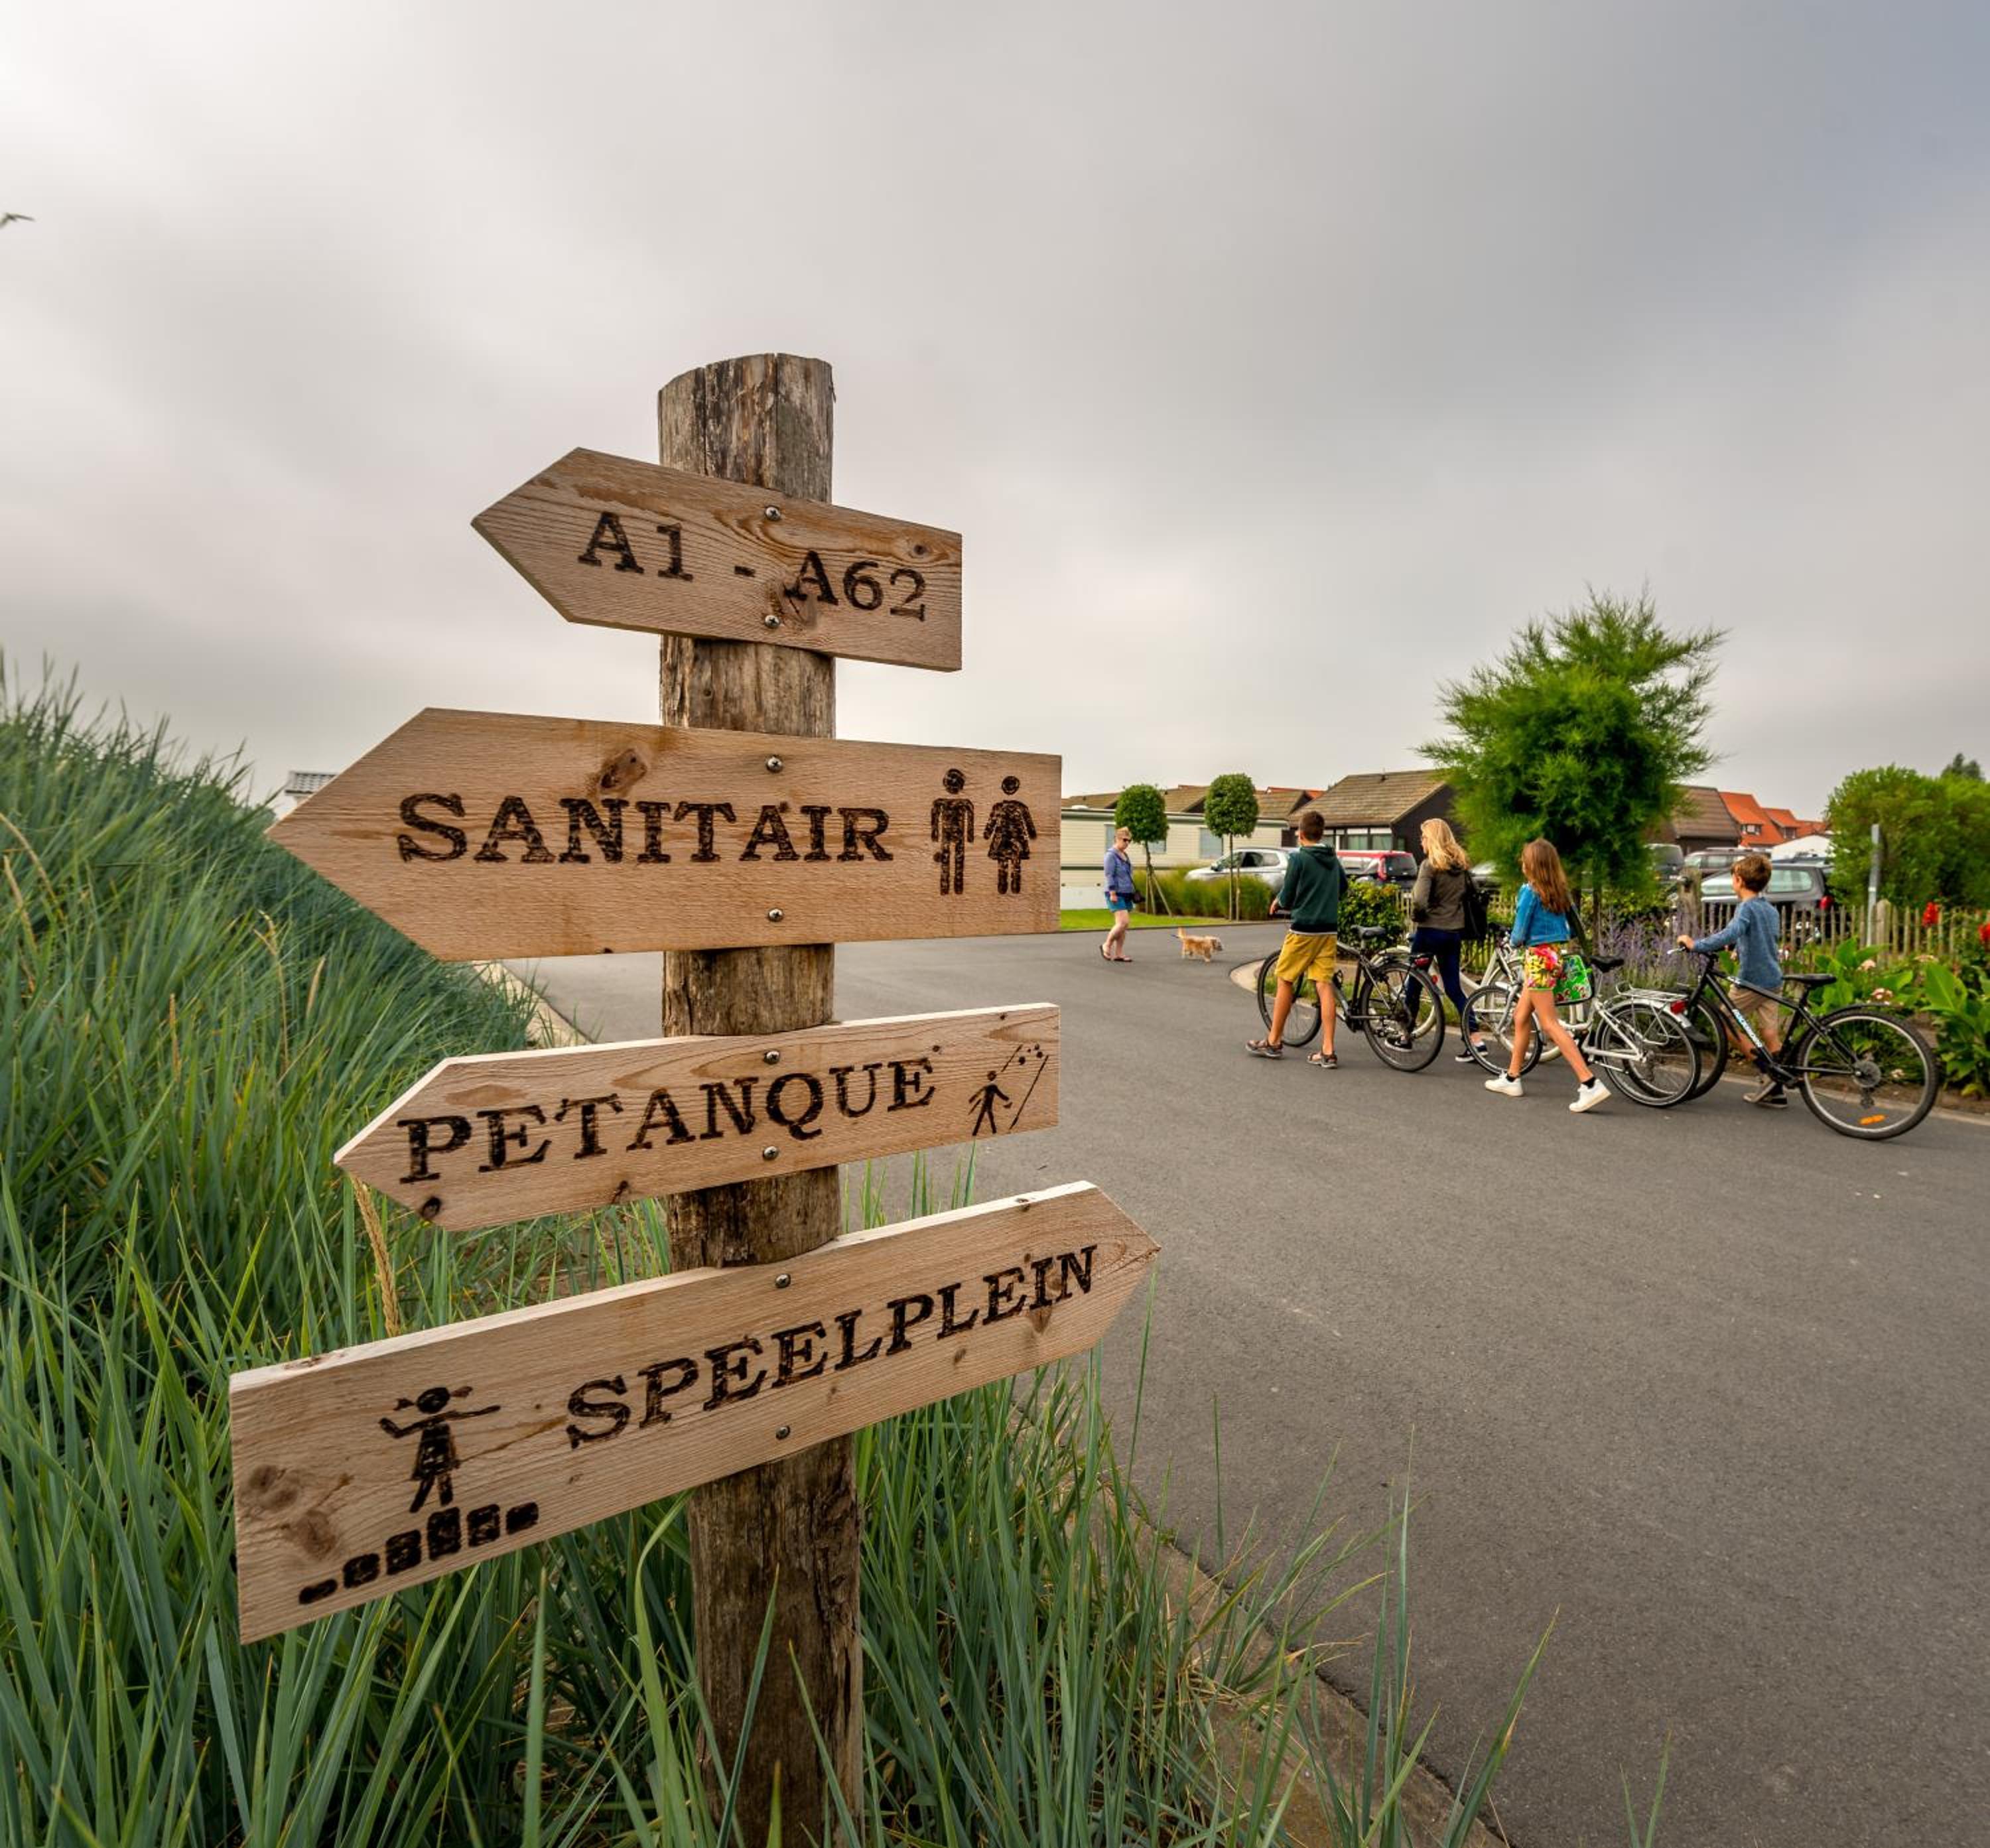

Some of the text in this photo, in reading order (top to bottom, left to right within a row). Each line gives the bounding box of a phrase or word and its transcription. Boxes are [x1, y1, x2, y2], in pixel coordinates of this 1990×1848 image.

[578, 511, 693, 581] A1
[783, 551, 926, 622] A62
[398, 793, 894, 864] SANITAIR
[398, 1058, 936, 1184] PETANQUE
[566, 1244, 1098, 1449] SPEELPLEIN
